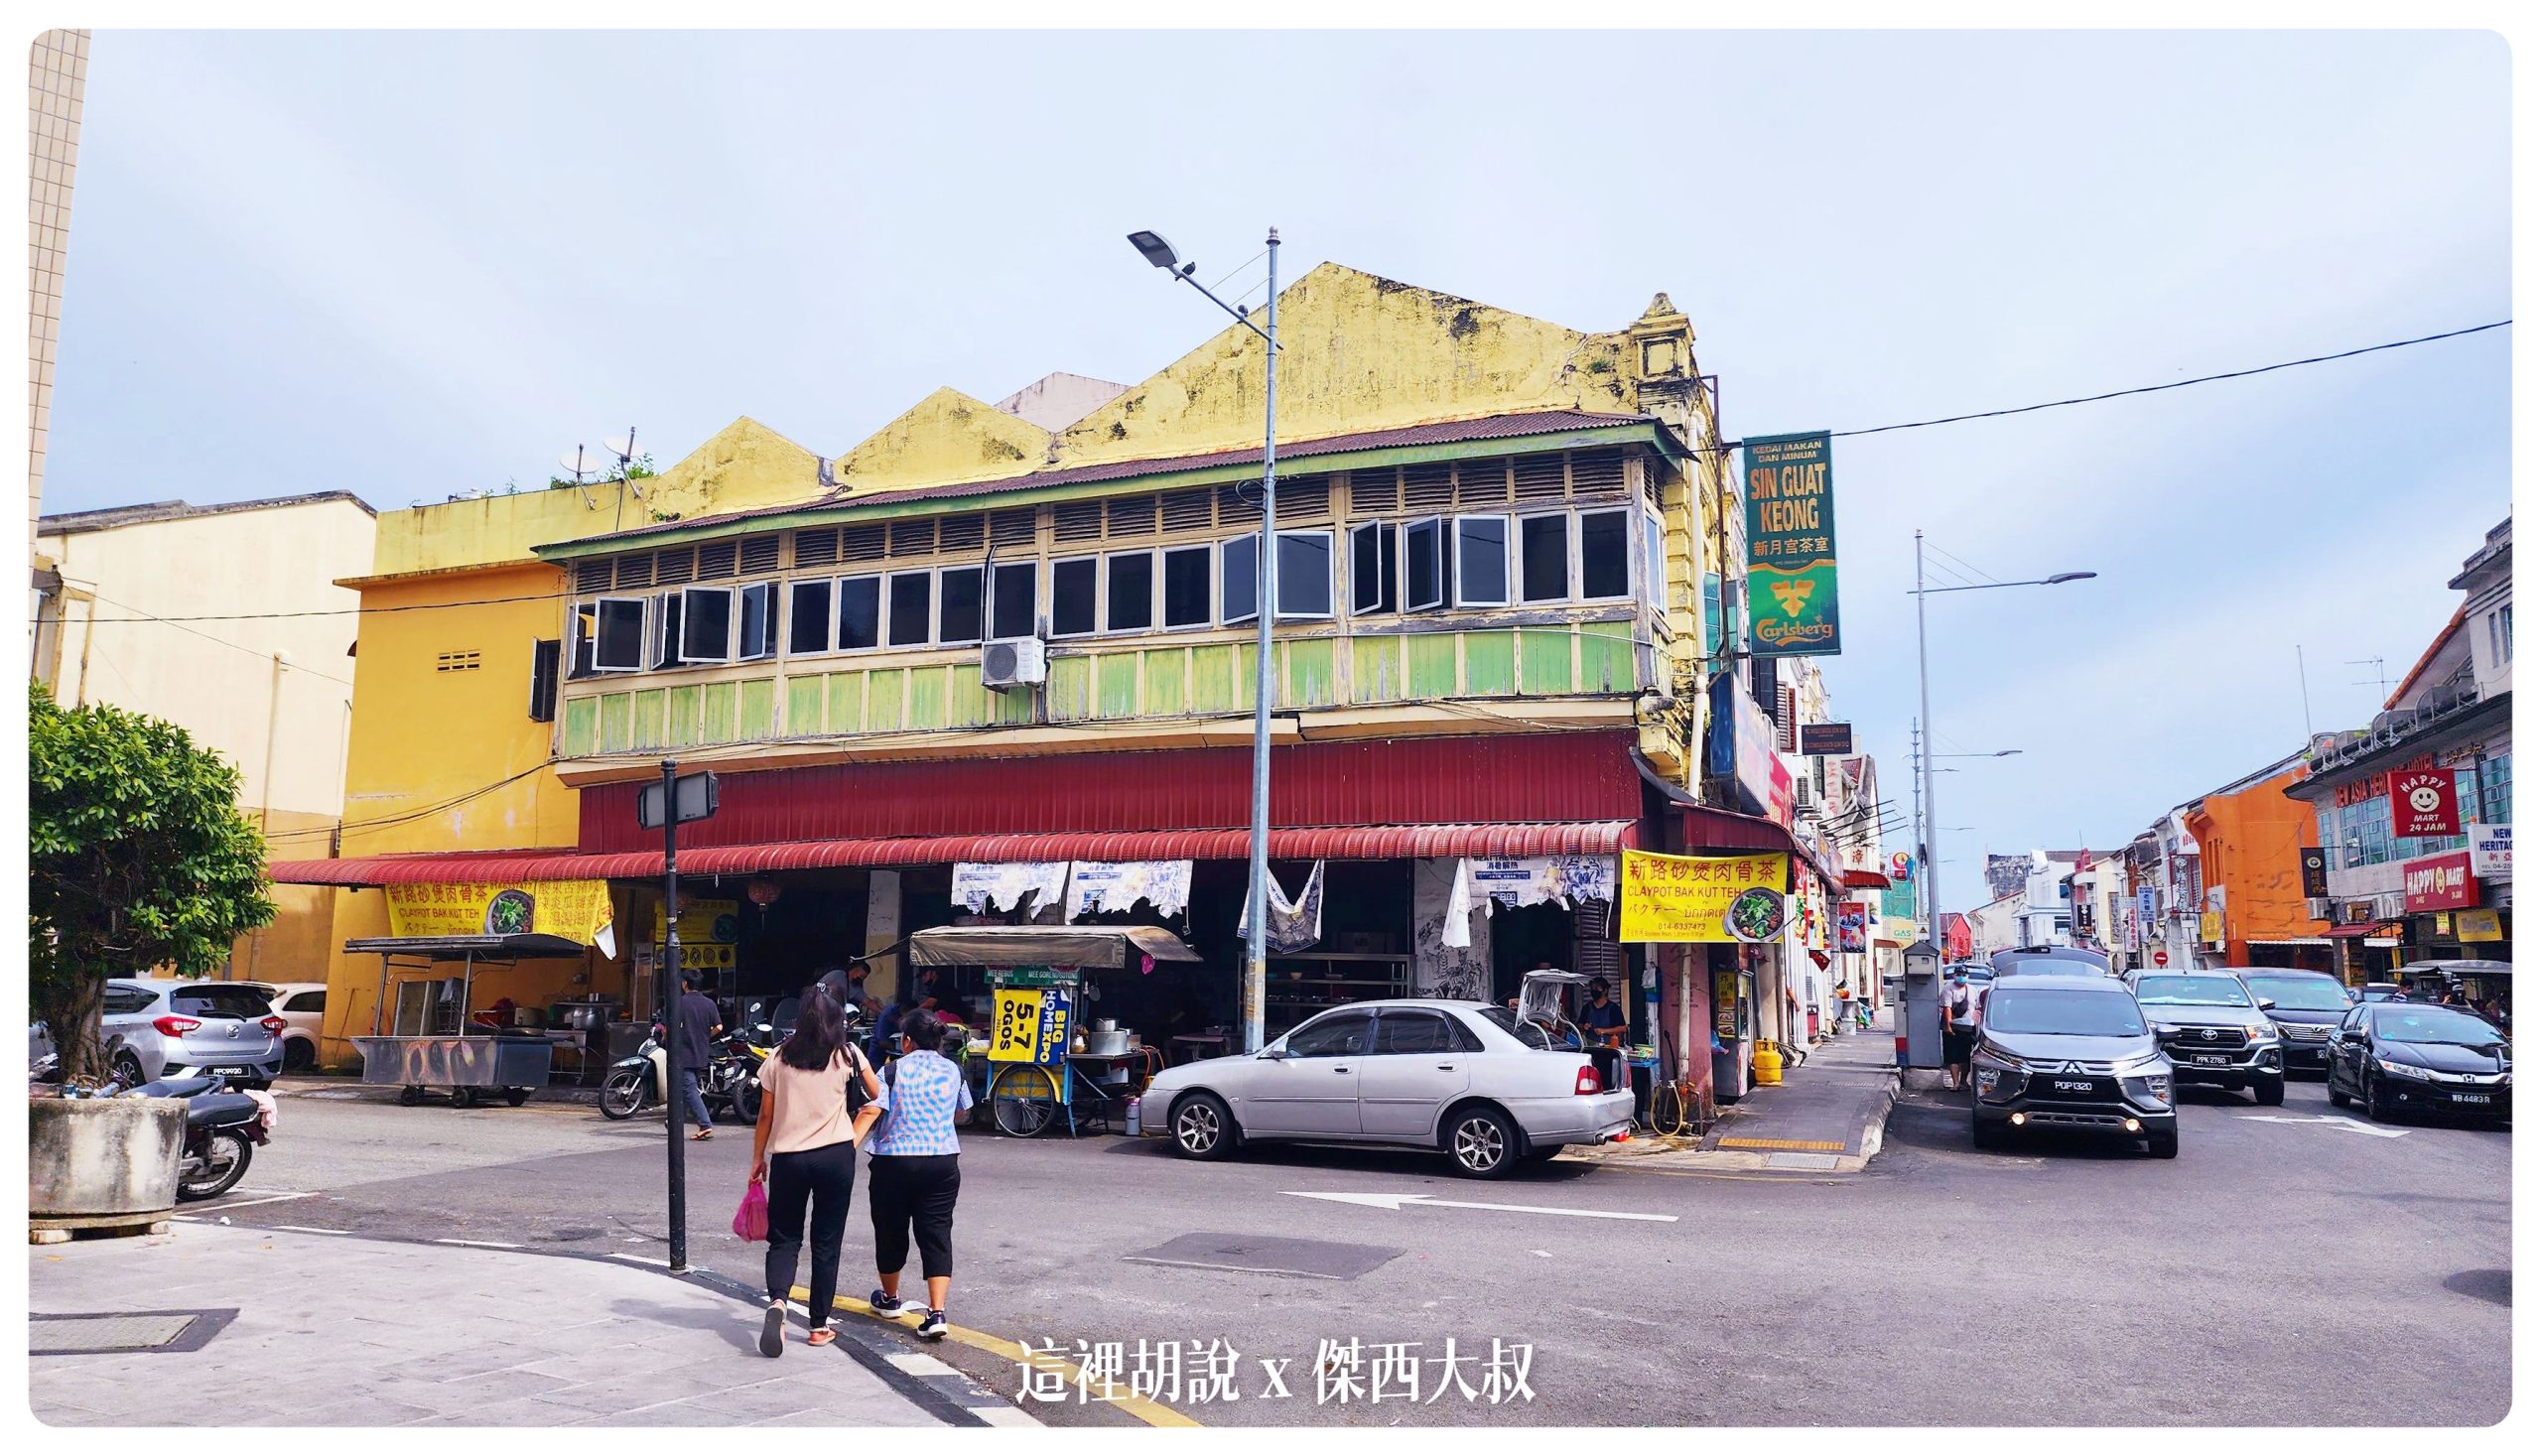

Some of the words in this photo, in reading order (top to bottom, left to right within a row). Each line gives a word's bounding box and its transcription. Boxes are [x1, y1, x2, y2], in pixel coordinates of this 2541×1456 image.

[1753, 446, 1782, 455] KEDAI
[1784, 441, 1822, 452] MAKAN
[1758, 455, 1780, 463] DAN
[1781, 451, 1817, 461] MINUM
[1750, 466, 1778, 500] SIN
[1782, 463, 1826, 497] GUAT
[1760, 497, 1819, 533] KEONG
[1756, 617, 1834, 646] Carlsberg
[2335, 784, 2349, 809] NEW
[2350, 777, 2368, 805] ASIA
[2399, 774, 2447, 793] HAPPY
[2413, 814, 2440, 823] MART
[2424, 823, 2447, 832] JAM
[2492, 828, 2511, 839] NEW
[1629, 860, 1777, 882] 新路砂煲肉骨茶
[2407, 868, 2435, 896] HAPPY
[2446, 866, 2465, 886] MART
[389, 882, 488, 904] 新路砂煲肉骨茶
[1628, 886, 1672, 898] CLAYPOT
[1675, 886, 1695, 897] BAK
[1697, 887, 1719, 897] KUT
[1721, 887, 1742, 898] TEH
[398, 907, 430, 918] CLAYPOT
[433, 907, 447, 918] BAK
[465, 908, 479, 919] TEH
[1658, 922, 1706, 931] 014-6337473
[1000, 999, 1014, 1050] OGOS
[1013, 1002, 1034, 1049] 5-7
[1039, 991, 1056, 1063] HOMEXPO
[1052, 1009, 1067, 1044] BIG
